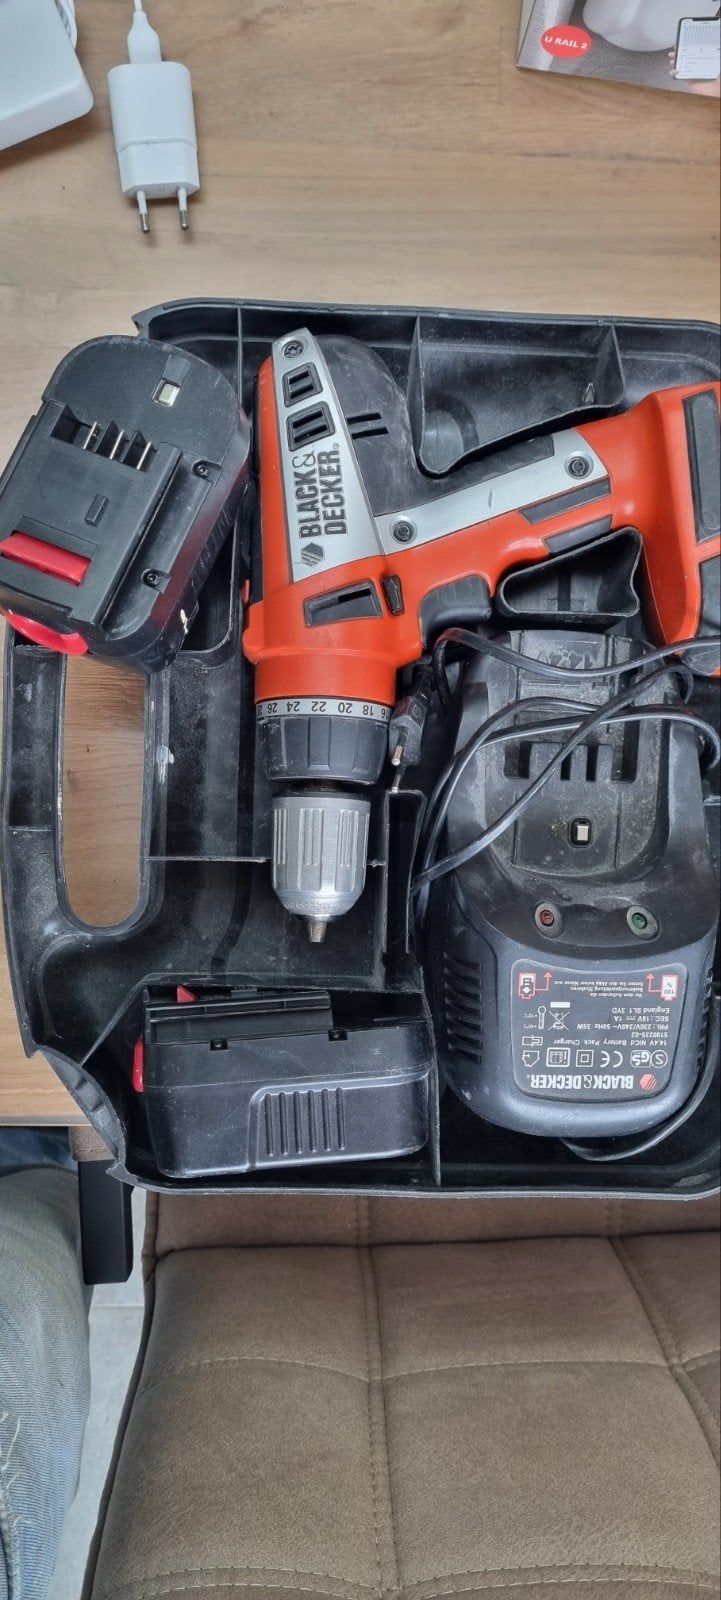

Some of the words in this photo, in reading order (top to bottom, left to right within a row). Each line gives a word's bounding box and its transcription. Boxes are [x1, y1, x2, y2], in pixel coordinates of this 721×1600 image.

[555, 38, 578, 48] RAIL
[268, 703, 277, 713] 26
[286, 702, 300, 712] 24
[312, 702, 326, 712] 22
[338, 702, 352, 713] 20
[363, 705, 374, 716] 18
[600, 1051, 623, 1068] CE
[631, 1051, 650, 1066] GS
